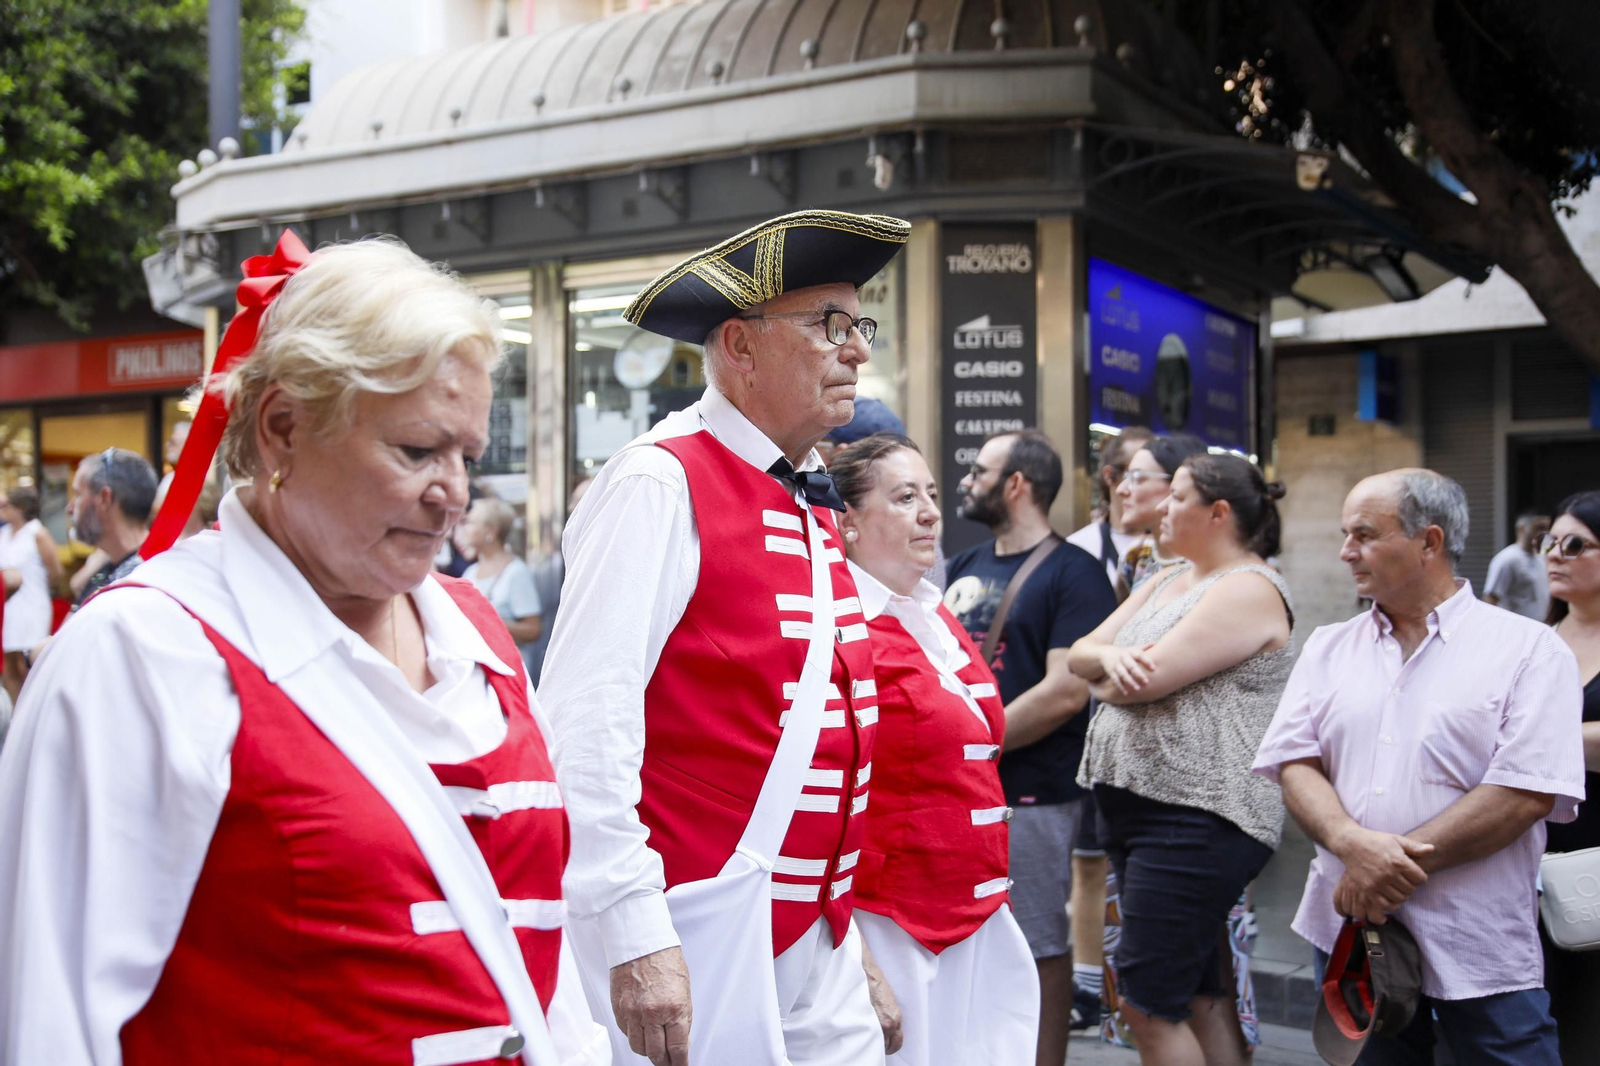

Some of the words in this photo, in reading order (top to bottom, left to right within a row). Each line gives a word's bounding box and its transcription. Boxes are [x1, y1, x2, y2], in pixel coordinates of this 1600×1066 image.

[947, 255, 1032, 274] TROYANO
[953, 330, 1024, 350] LOTUS
[1102, 345, 1140, 373] CASIO
[954, 360, 1024, 379] CASIO
[954, 390, 1024, 407] FESTINA
[954, 418, 1024, 436] CALYPSO
